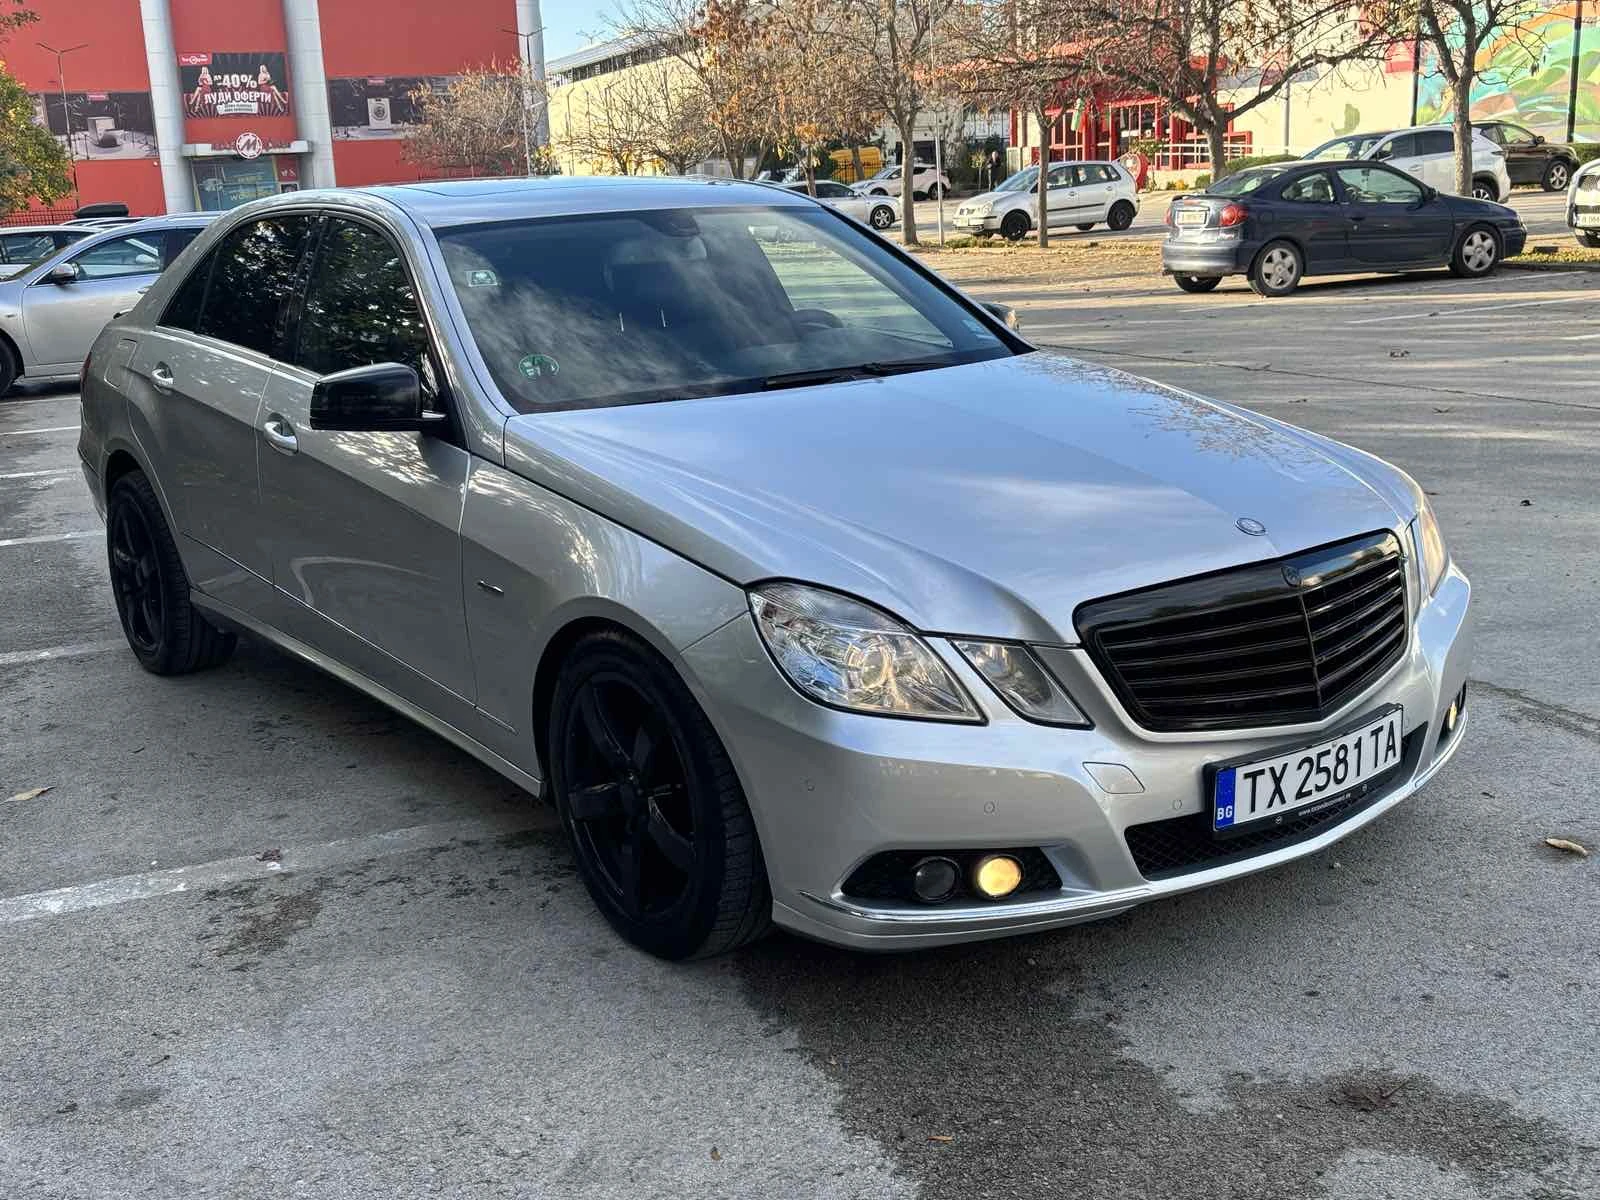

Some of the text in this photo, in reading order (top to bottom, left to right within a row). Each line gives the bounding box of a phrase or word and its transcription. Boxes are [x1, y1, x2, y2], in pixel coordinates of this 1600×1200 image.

[204, 91, 272, 105] ЛУДИ ОФЕРТИ
[1244, 762, 1289, 814] TX
[1295, 736, 1363, 800] 2581
[1370, 720, 1397, 769] TA
[1216, 805, 1233, 821] BG
